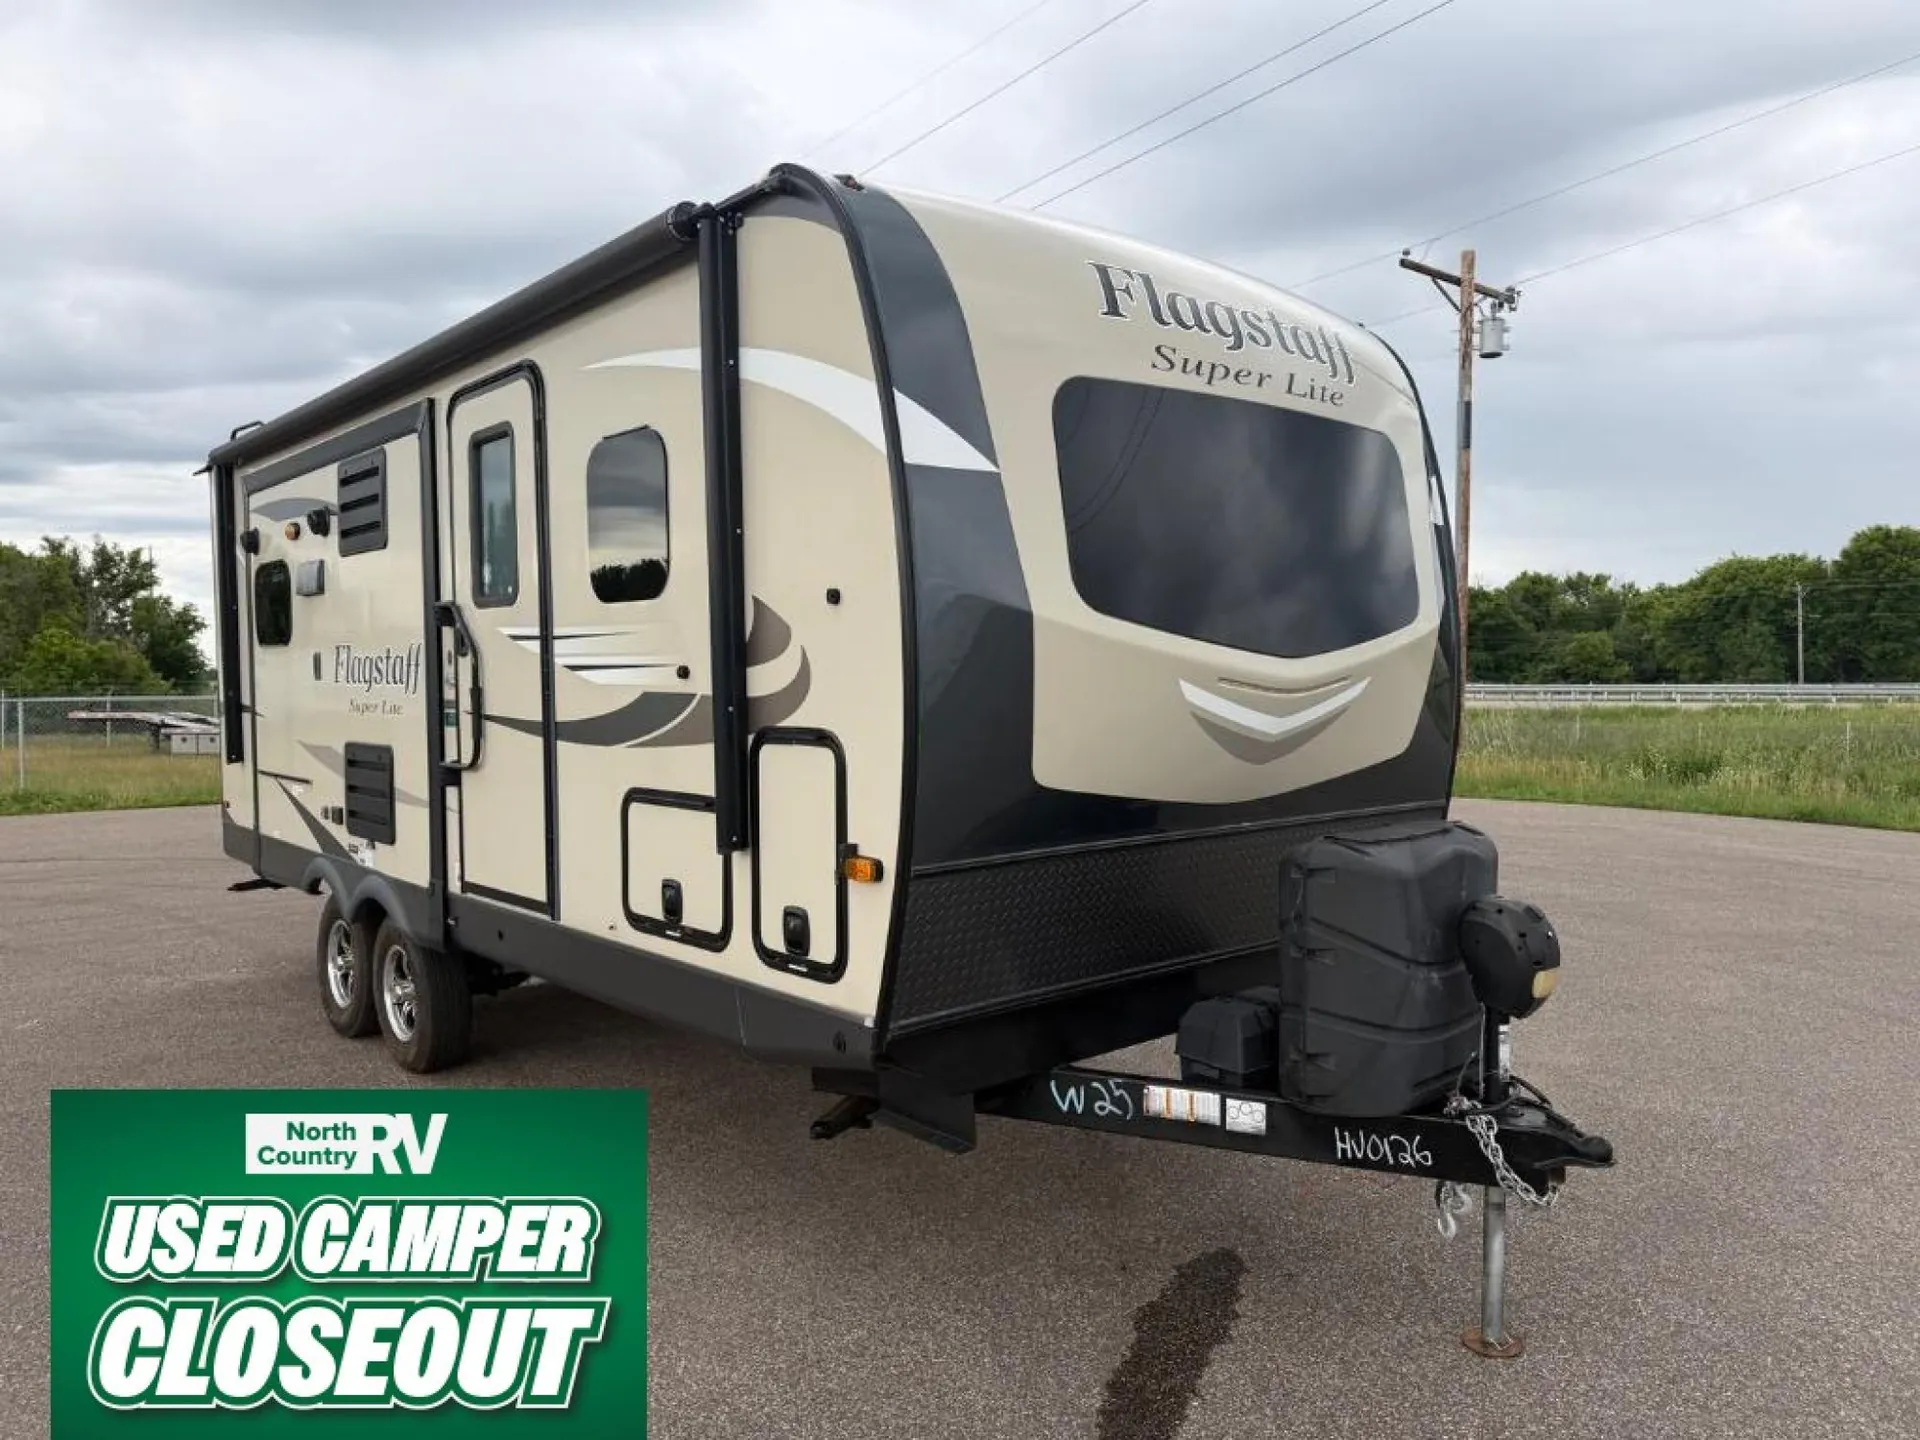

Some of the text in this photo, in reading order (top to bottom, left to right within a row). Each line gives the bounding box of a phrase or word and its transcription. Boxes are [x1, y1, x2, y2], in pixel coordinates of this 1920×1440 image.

[1087, 261, 1355, 384] Flagstaff
[1150, 344, 1345, 407] Super Lite
[334, 643, 422, 694] Flagstaff
[349, 699, 378, 716] Super
